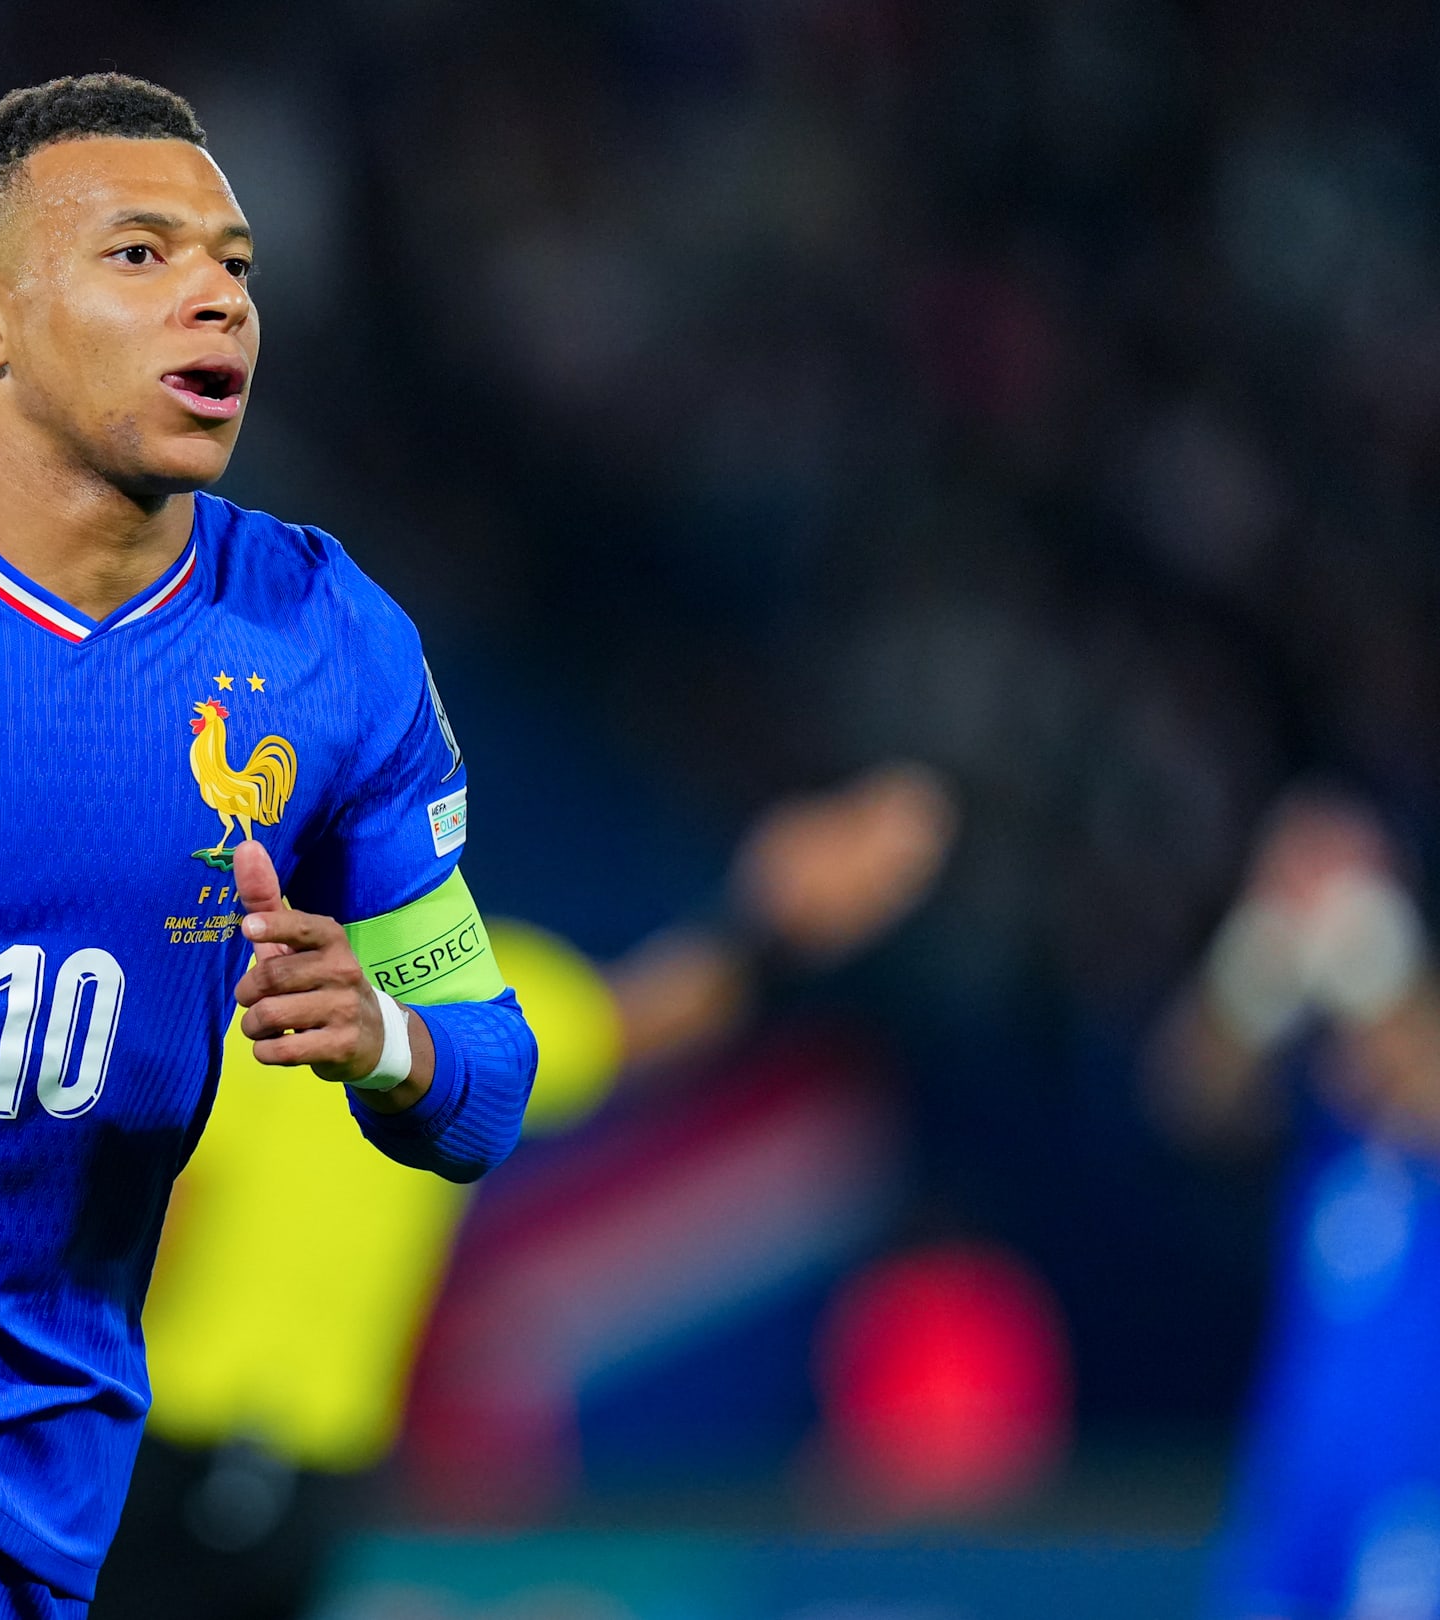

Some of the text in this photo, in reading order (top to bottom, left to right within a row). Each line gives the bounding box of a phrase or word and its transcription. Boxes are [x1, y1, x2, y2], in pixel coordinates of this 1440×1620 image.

[431, 802, 447, 816] UEFA
[164, 916, 199, 929] FRANCE
[170, 930, 182, 944] 10
[183, 929, 221, 944] OCTOBRE
[375, 922, 480, 992] RESPECT
